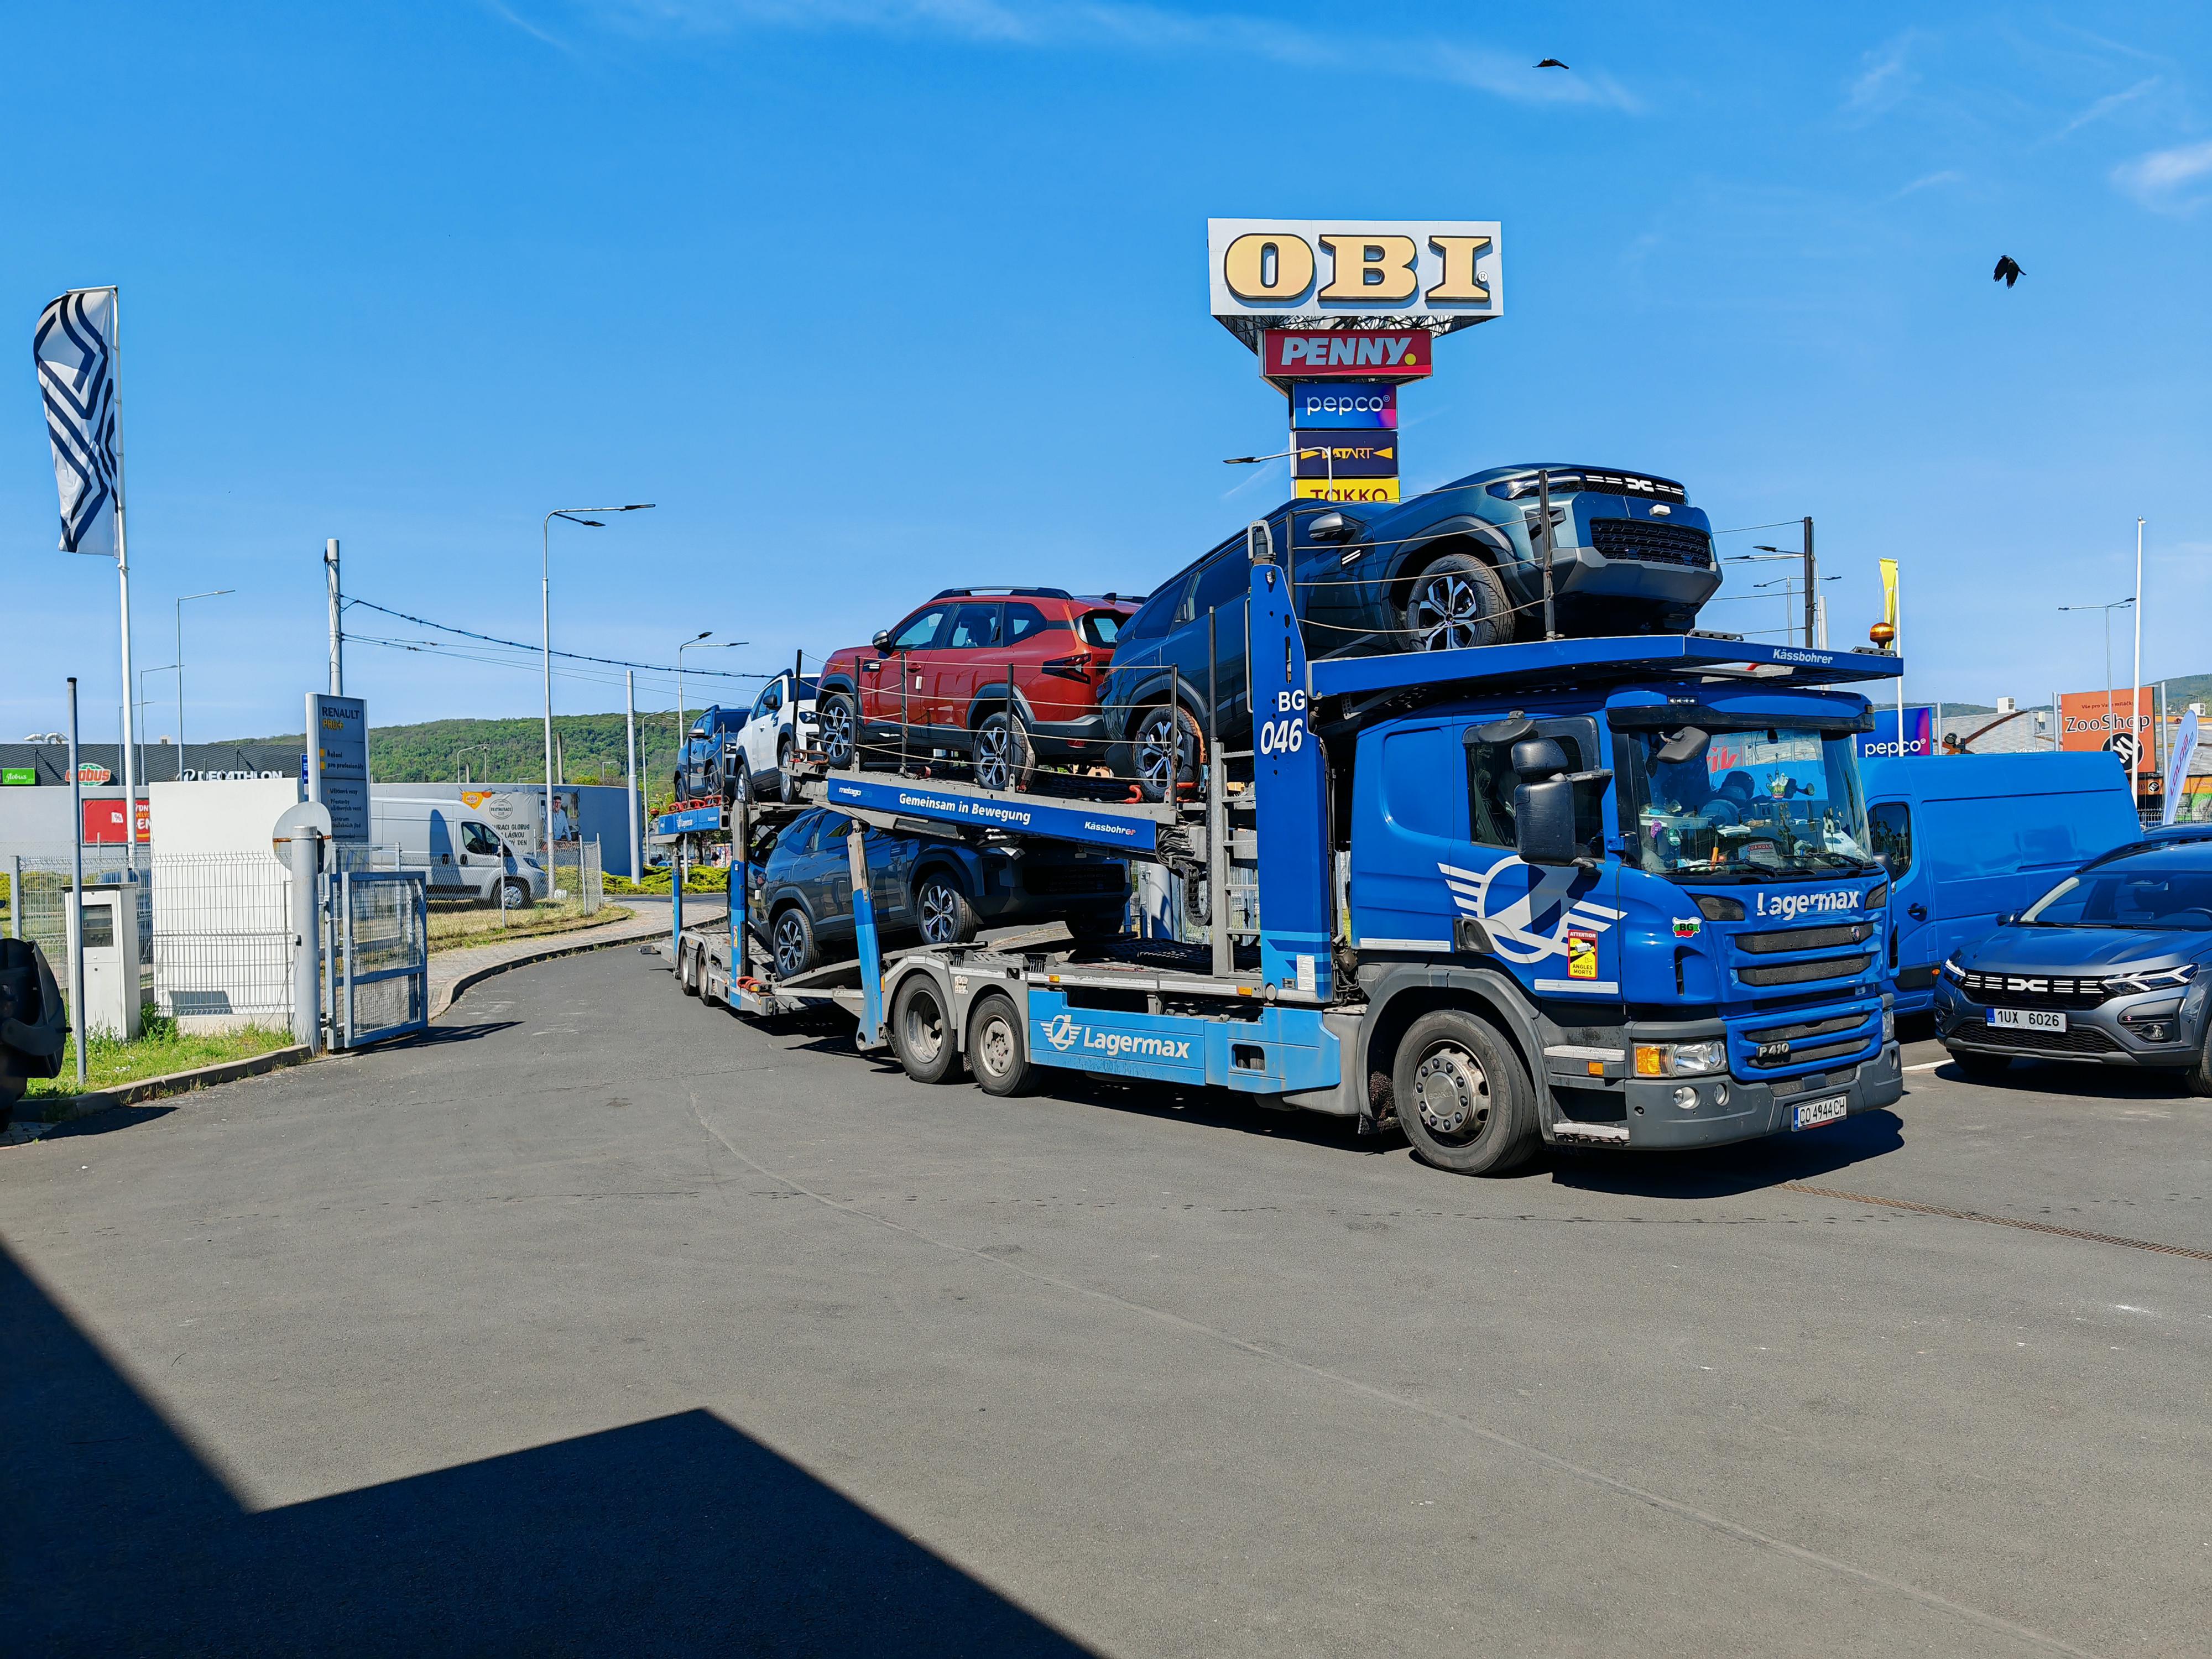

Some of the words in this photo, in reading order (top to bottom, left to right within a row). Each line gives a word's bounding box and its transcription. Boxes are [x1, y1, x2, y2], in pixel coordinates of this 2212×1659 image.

[1224, 233, 1492, 301] OBI
[1307, 395, 1384, 416] pepco
[1773, 649, 1833, 664] Kässbohrer
[1279, 689, 1305, 712] BG
[321, 707, 359, 719] RENAULT
[1261, 718, 1303, 755] 046
[197, 770, 283, 781] DECATHLON
[899, 793, 956, 812] Gemeinsam
[958, 801, 968, 813] in
[972, 803, 1031, 826] Bewegung
[1084, 821, 1136, 836] Kässbohrer
[1756, 890, 1859, 921] Lagermax
[1679, 923, 1694, 931] BG
[1997, 1010, 2018, 1024] 1UX
[2029, 1013, 2059, 1026] 6026
[1083, 1027, 1191, 1058] Lagermax
[1759, 1047, 1767, 1057] P
[1769, 1042, 1790, 1055] 410
[1799, 1107, 1811, 1124] CO
[1813, 1103, 1833, 1120] 4944
[1833, 1098, 1845, 1115] CH
